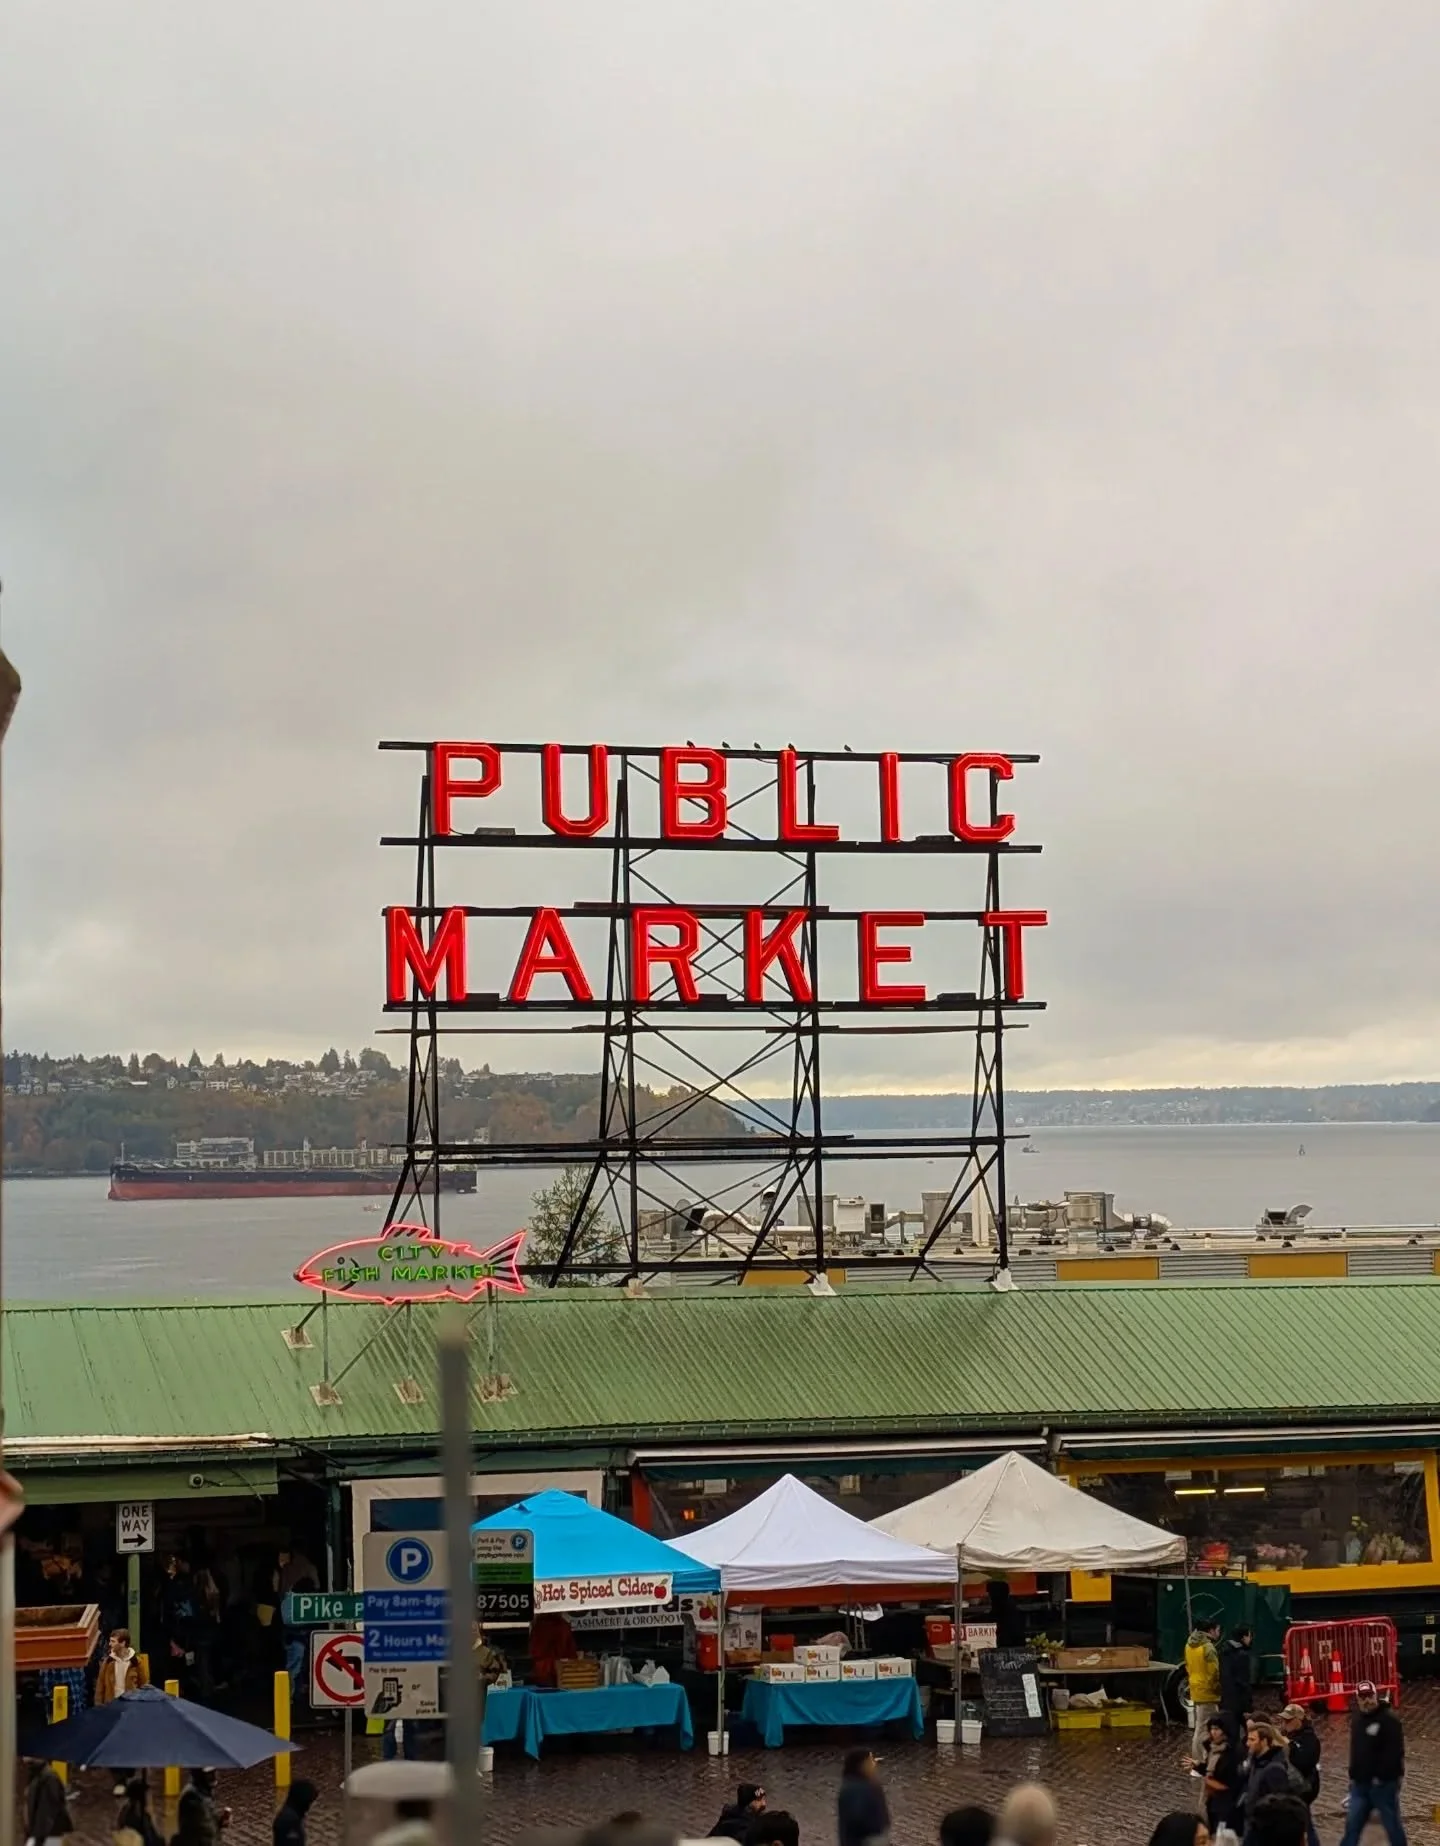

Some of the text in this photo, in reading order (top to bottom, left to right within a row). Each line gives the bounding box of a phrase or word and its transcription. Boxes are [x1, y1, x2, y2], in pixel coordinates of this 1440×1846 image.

[431, 741, 1015, 842] PUBLIC
[386, 905, 1048, 1004] MARKET
[377, 1244, 445, 1262] CITY
[322, 1264, 497, 1283] FISH MARKET
[121, 1505, 149, 1518] ONE
[121, 1519, 150, 1532] WAY
[401, 1547, 422, 1575] P
[541, 1574, 654, 1604] Hot Spiced Cider
[300, 1596, 344, 1618] Pike
[367, 1594, 389, 1609] Pay
[477, 1594, 530, 1609] 87505
[623, 1617, 632, 1626] &
[633, 1614, 675, 1625] ORONDO
[368, 1629, 380, 1647] 2
[384, 1634, 423, 1647] Hours
